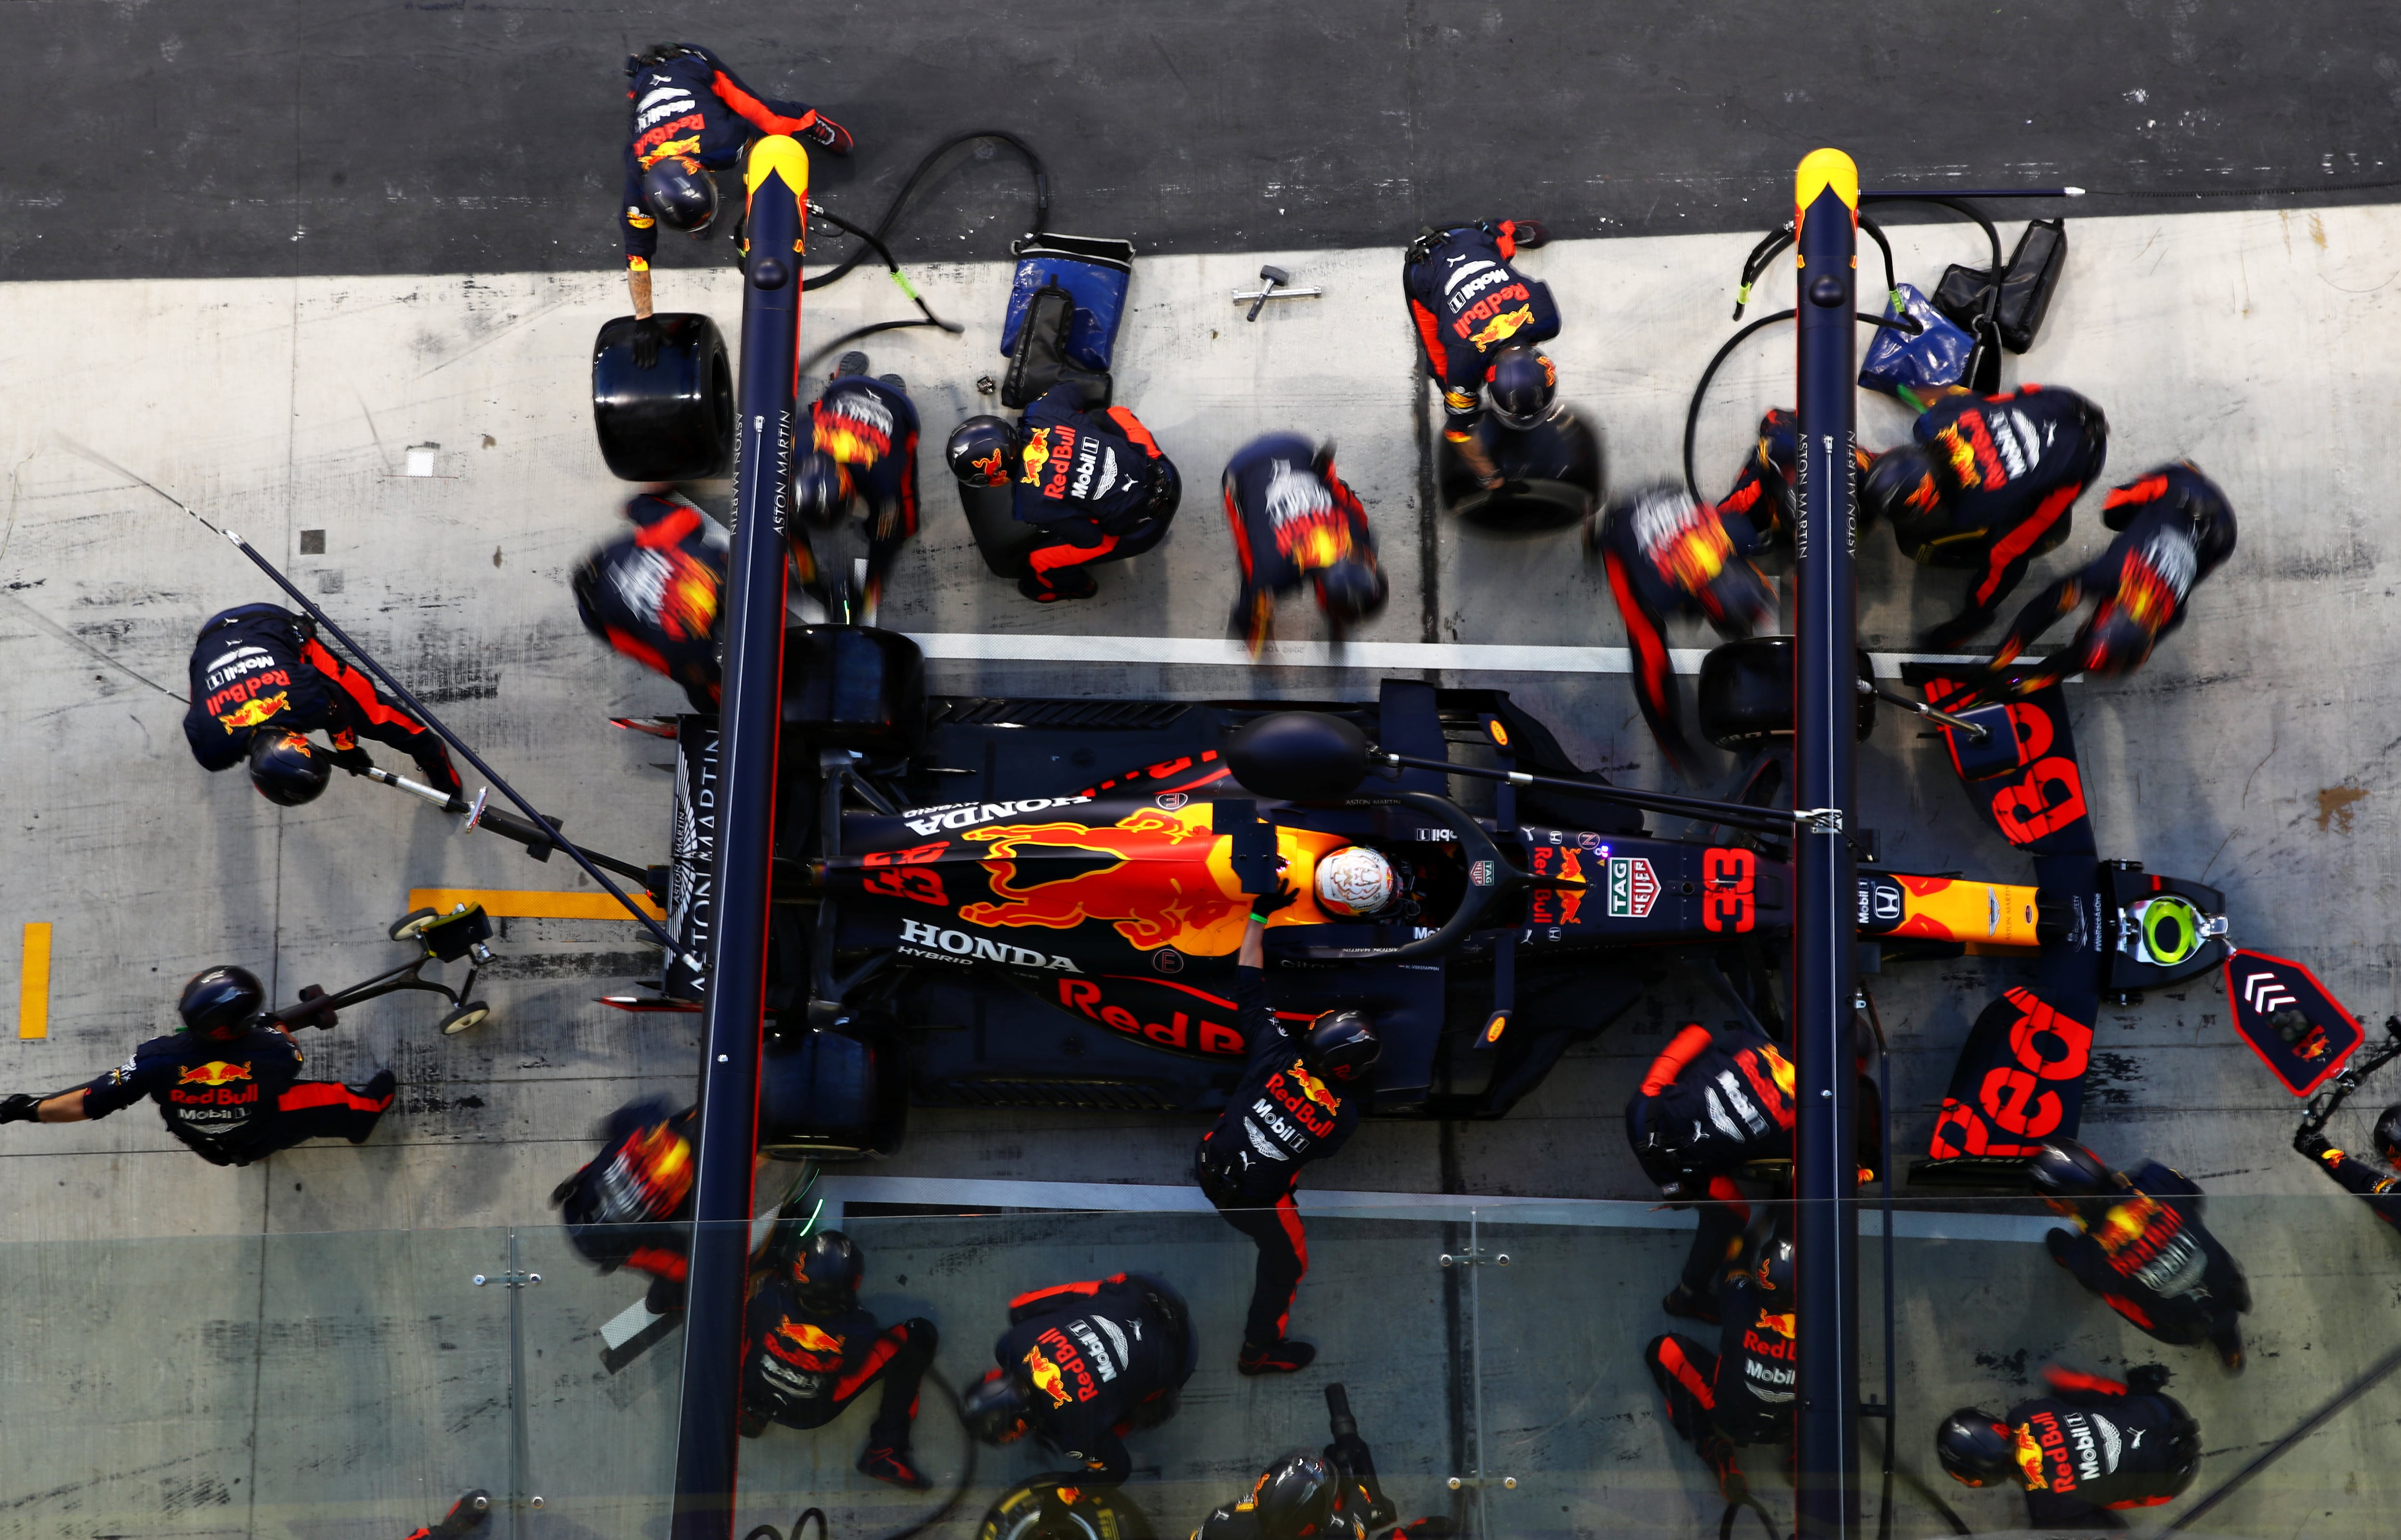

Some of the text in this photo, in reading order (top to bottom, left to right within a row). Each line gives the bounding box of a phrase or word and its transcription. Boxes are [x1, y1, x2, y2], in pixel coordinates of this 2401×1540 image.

[730, 413, 743, 536] ASTON MARTIN
[772, 410, 790, 537] ASTON MARTIN
[1070, 452, 1097, 500] Mobil
[1798, 433, 1808, 559] ASTON MARTIN
[1846, 430, 1856, 559] ASTON MARTIN
[903, 801, 980, 818] HYBRID
[904, 796, 1092, 836] HONDA
[1473, 863, 1482, 884] HEUER
[1614, 863, 1627, 912] TAG
[1635, 861, 1655, 914] HEUER
[1702, 847, 1755, 933] 33
[690, 871, 712, 992] ATON
[1858, 890, 1869, 924] Mobil
[897, 946, 974, 965] HYBRID
[899, 918, 1085, 974] HONDA
[1058, 978, 1189, 1049] Red
[1929, 986, 2094, 1160] Red
[178, 1108, 232, 1120] Mobil
[1252, 1097, 1296, 1142] Mobil
[1078, 1332, 1117, 1383] Mobil
[1743, 1329, 1786, 1360] Red
[1745, 1358, 1796, 1386] Mobil
[2069, 1426, 2101, 1481] Mobil
